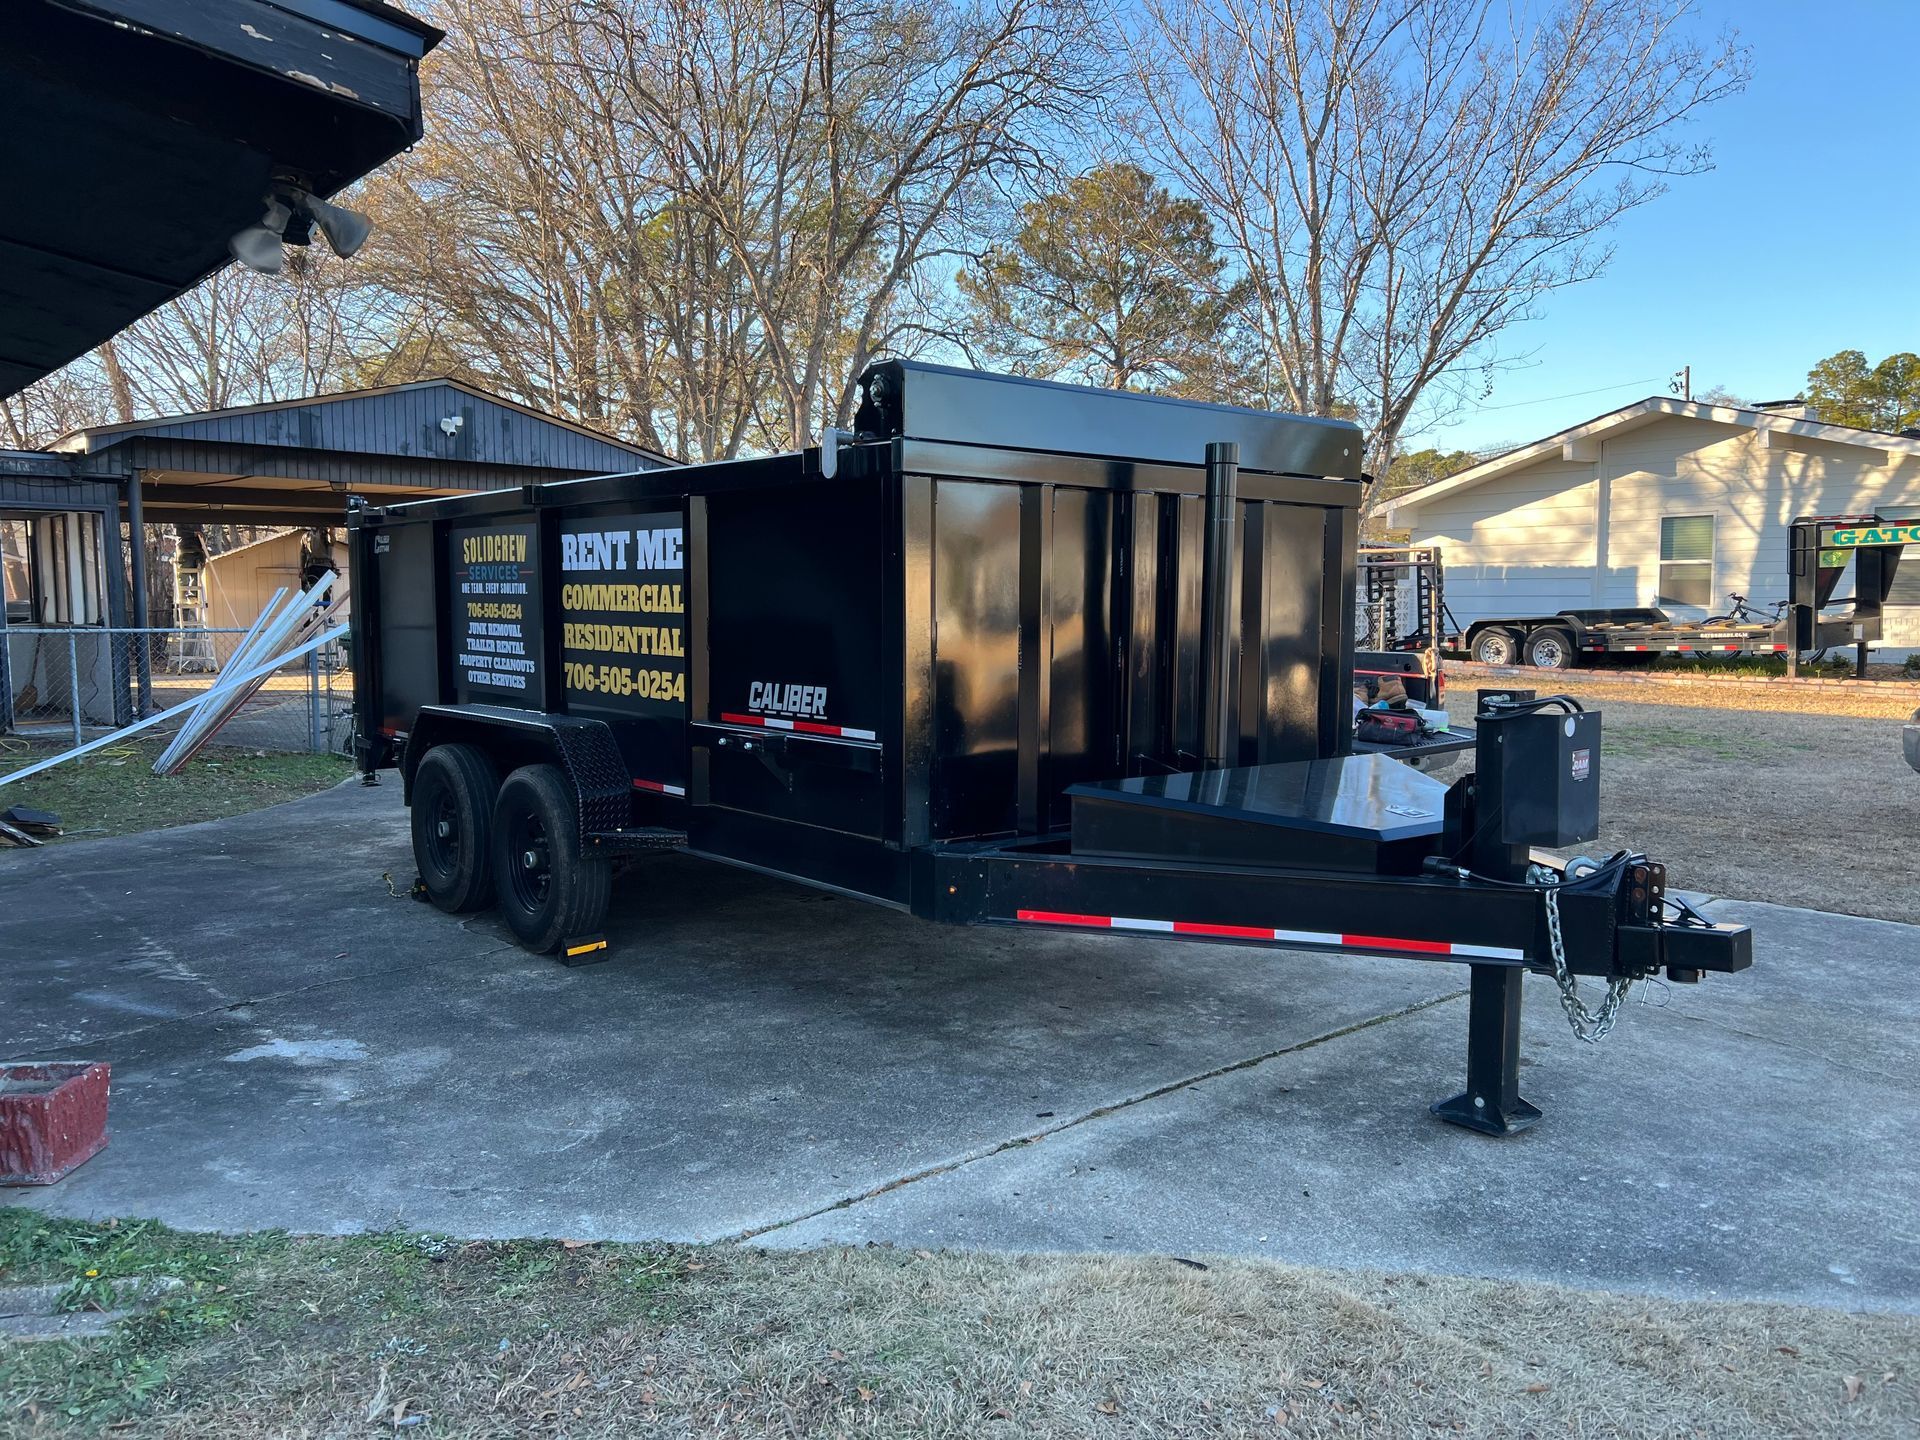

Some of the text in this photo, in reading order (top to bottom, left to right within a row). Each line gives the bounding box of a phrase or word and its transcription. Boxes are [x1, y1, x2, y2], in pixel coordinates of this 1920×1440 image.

[463, 534, 527, 564] SOLIDCREW
[561, 528, 683, 571] RENT ME
[469, 565, 519, 580] SERVICES
[462, 582, 470, 594] ONE
[485, 582, 499, 594] EVERY
[562, 584, 684, 613] COMMERCIAL
[467, 602, 522, 619] 706-505-0254
[468, 622, 522, 637] JUNK REMOVAL
[466, 638, 525, 655] TRAILER RENTAL
[563, 623, 685, 657] RESIDENTIAL
[459, 653, 535, 673] PROPERTY CLEANOUTS
[468, 670, 526, 689] OTHER SERVICES
[564, 662, 685, 702] 706-505-0254
[748, 681, 827, 715] CALIBER
